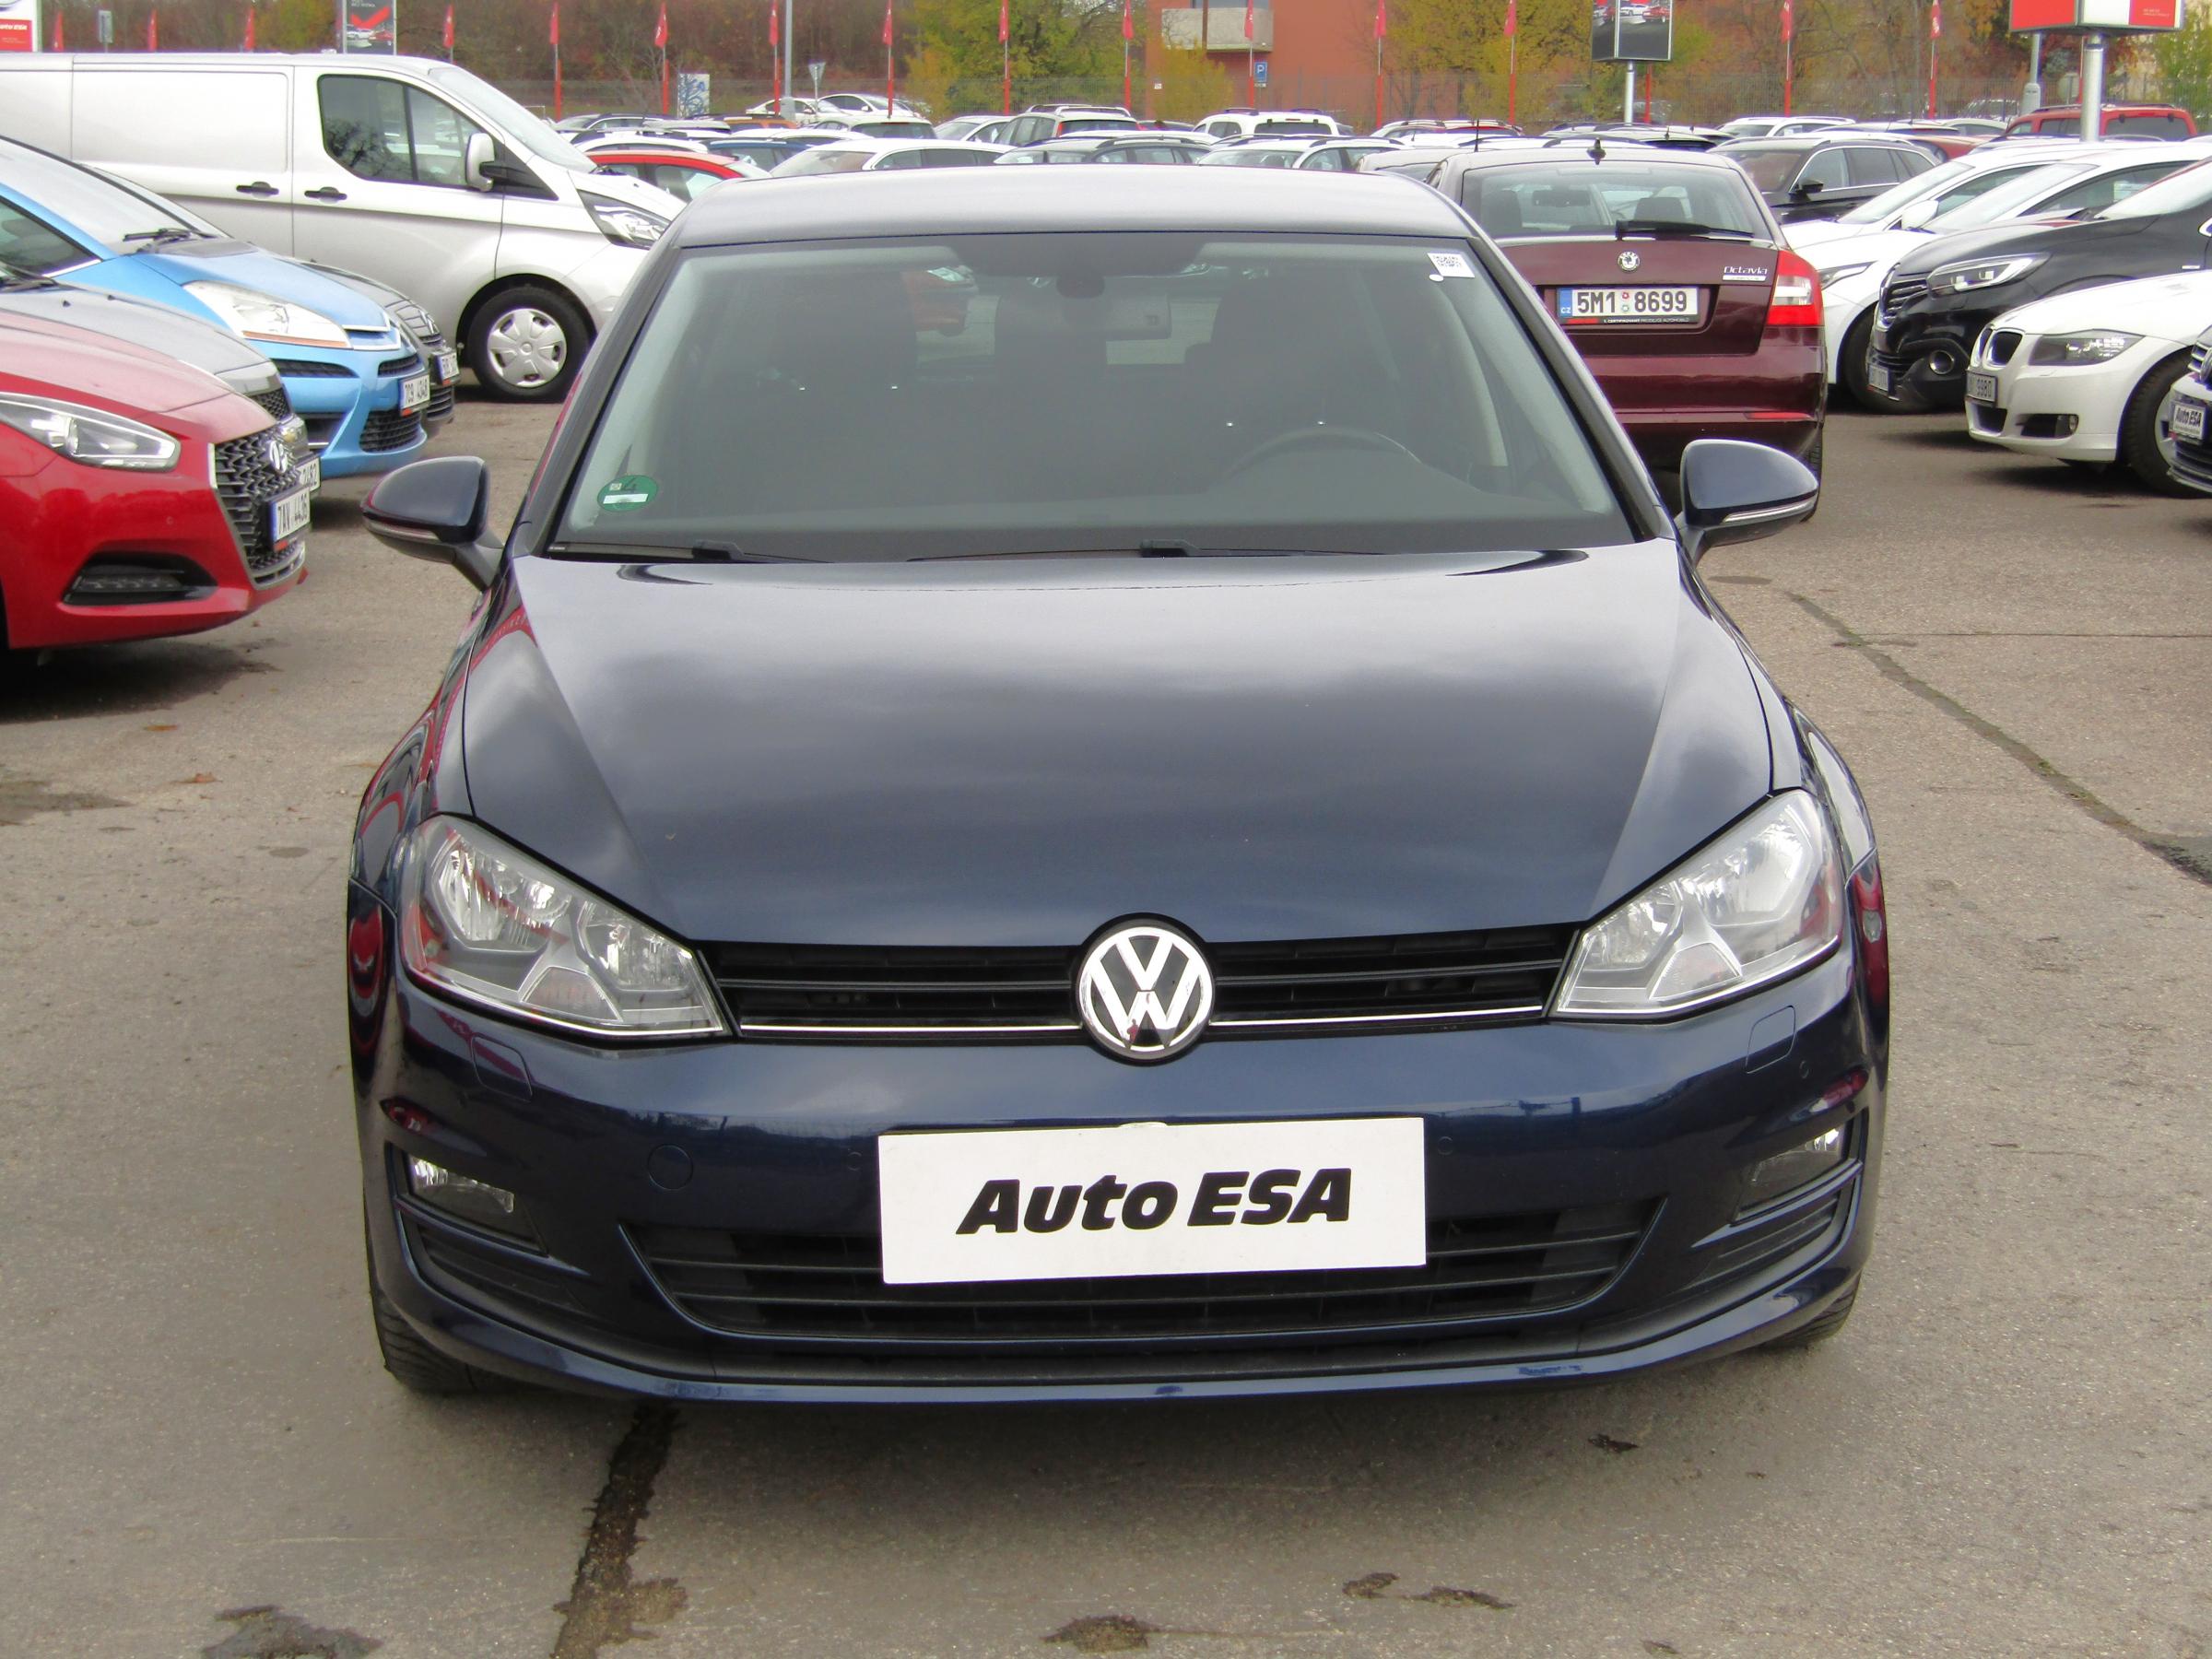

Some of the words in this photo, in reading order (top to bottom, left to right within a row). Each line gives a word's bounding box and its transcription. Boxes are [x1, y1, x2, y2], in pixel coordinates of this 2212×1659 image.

[1256, 65, 1265, 74] P
[1724, 265, 1768, 275] Octavia
[1577, 291, 1616, 313] 5M1
[1634, 290, 1688, 312] 8699
[955, 1174, 1179, 1235] Auto
[1187, 1168, 1352, 1227] ESA
